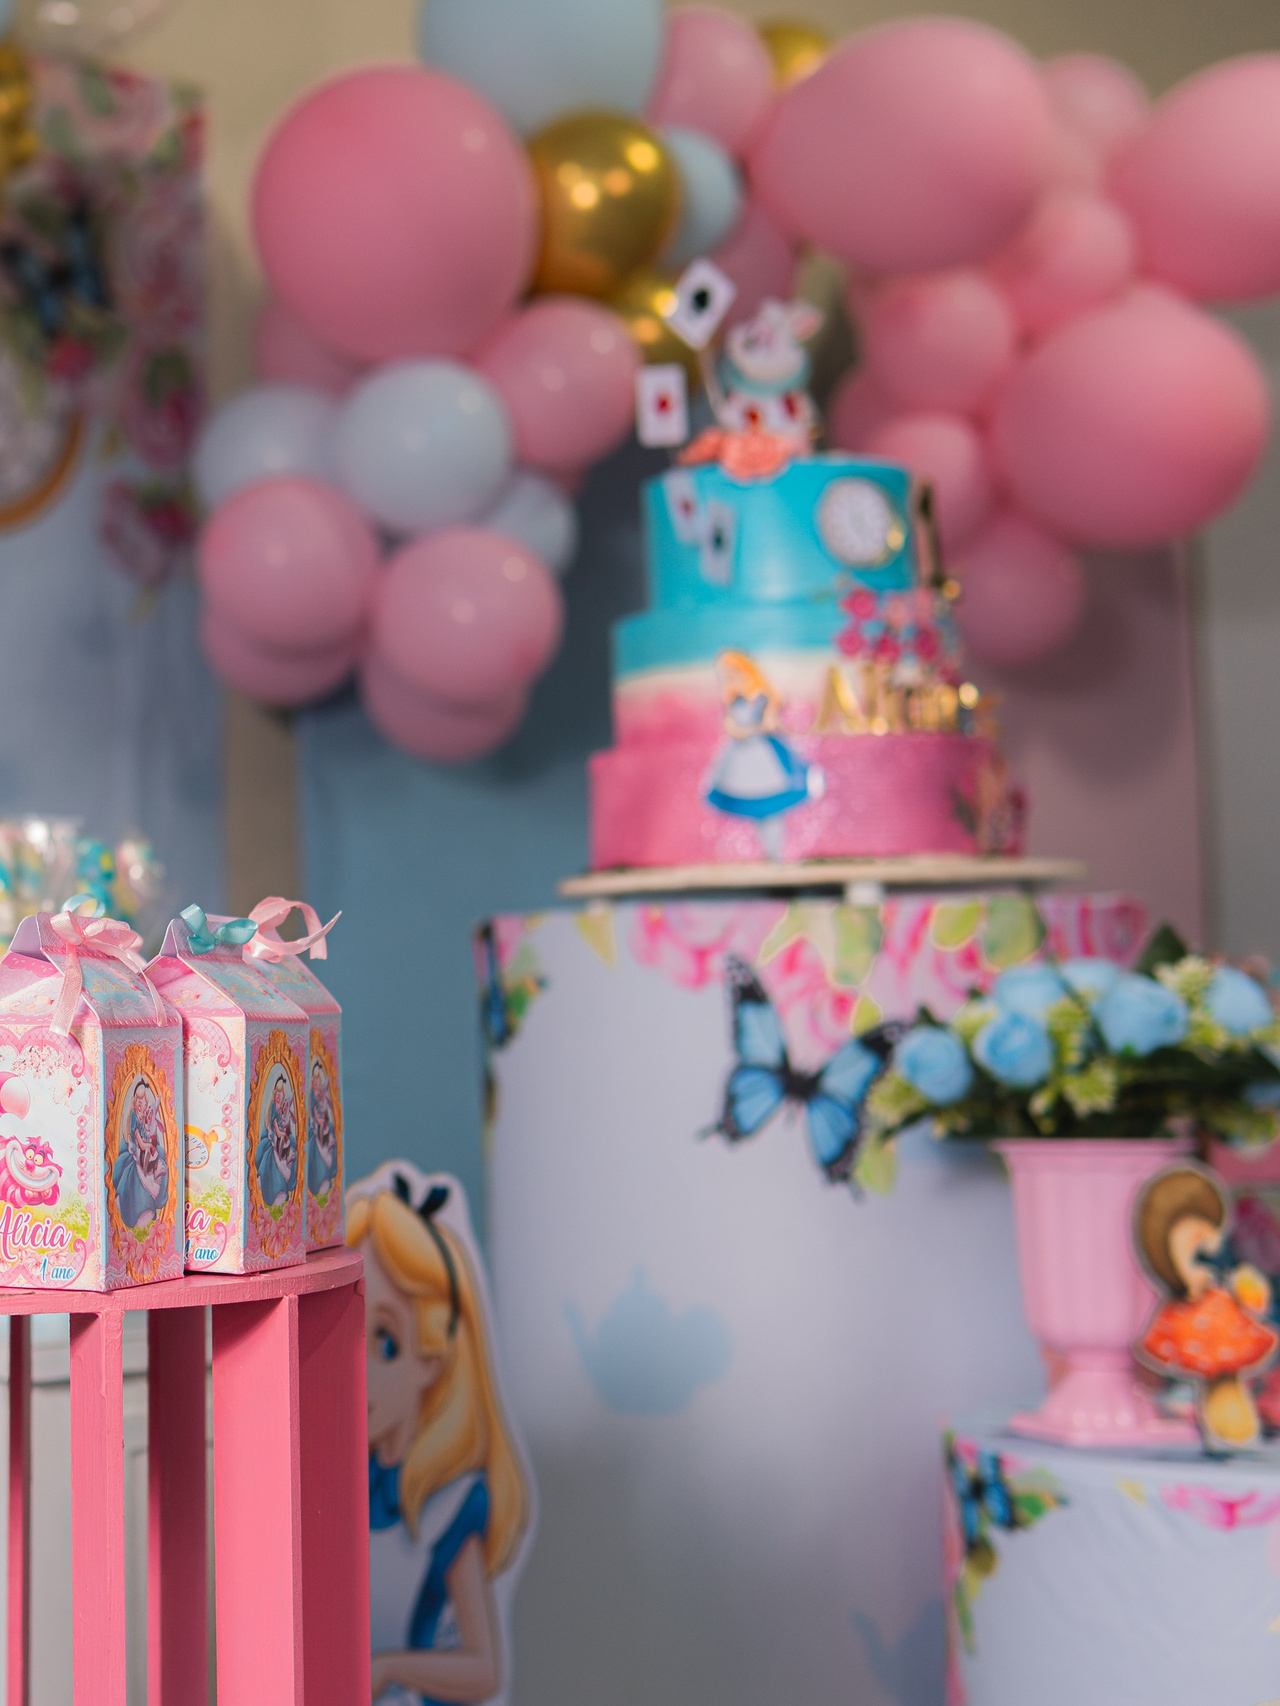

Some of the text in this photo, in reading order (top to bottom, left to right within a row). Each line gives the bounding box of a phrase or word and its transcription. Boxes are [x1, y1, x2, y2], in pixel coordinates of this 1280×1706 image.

[194, 1248, 220, 1260] ano
[39, 1257, 76, 1282] 1 ano
